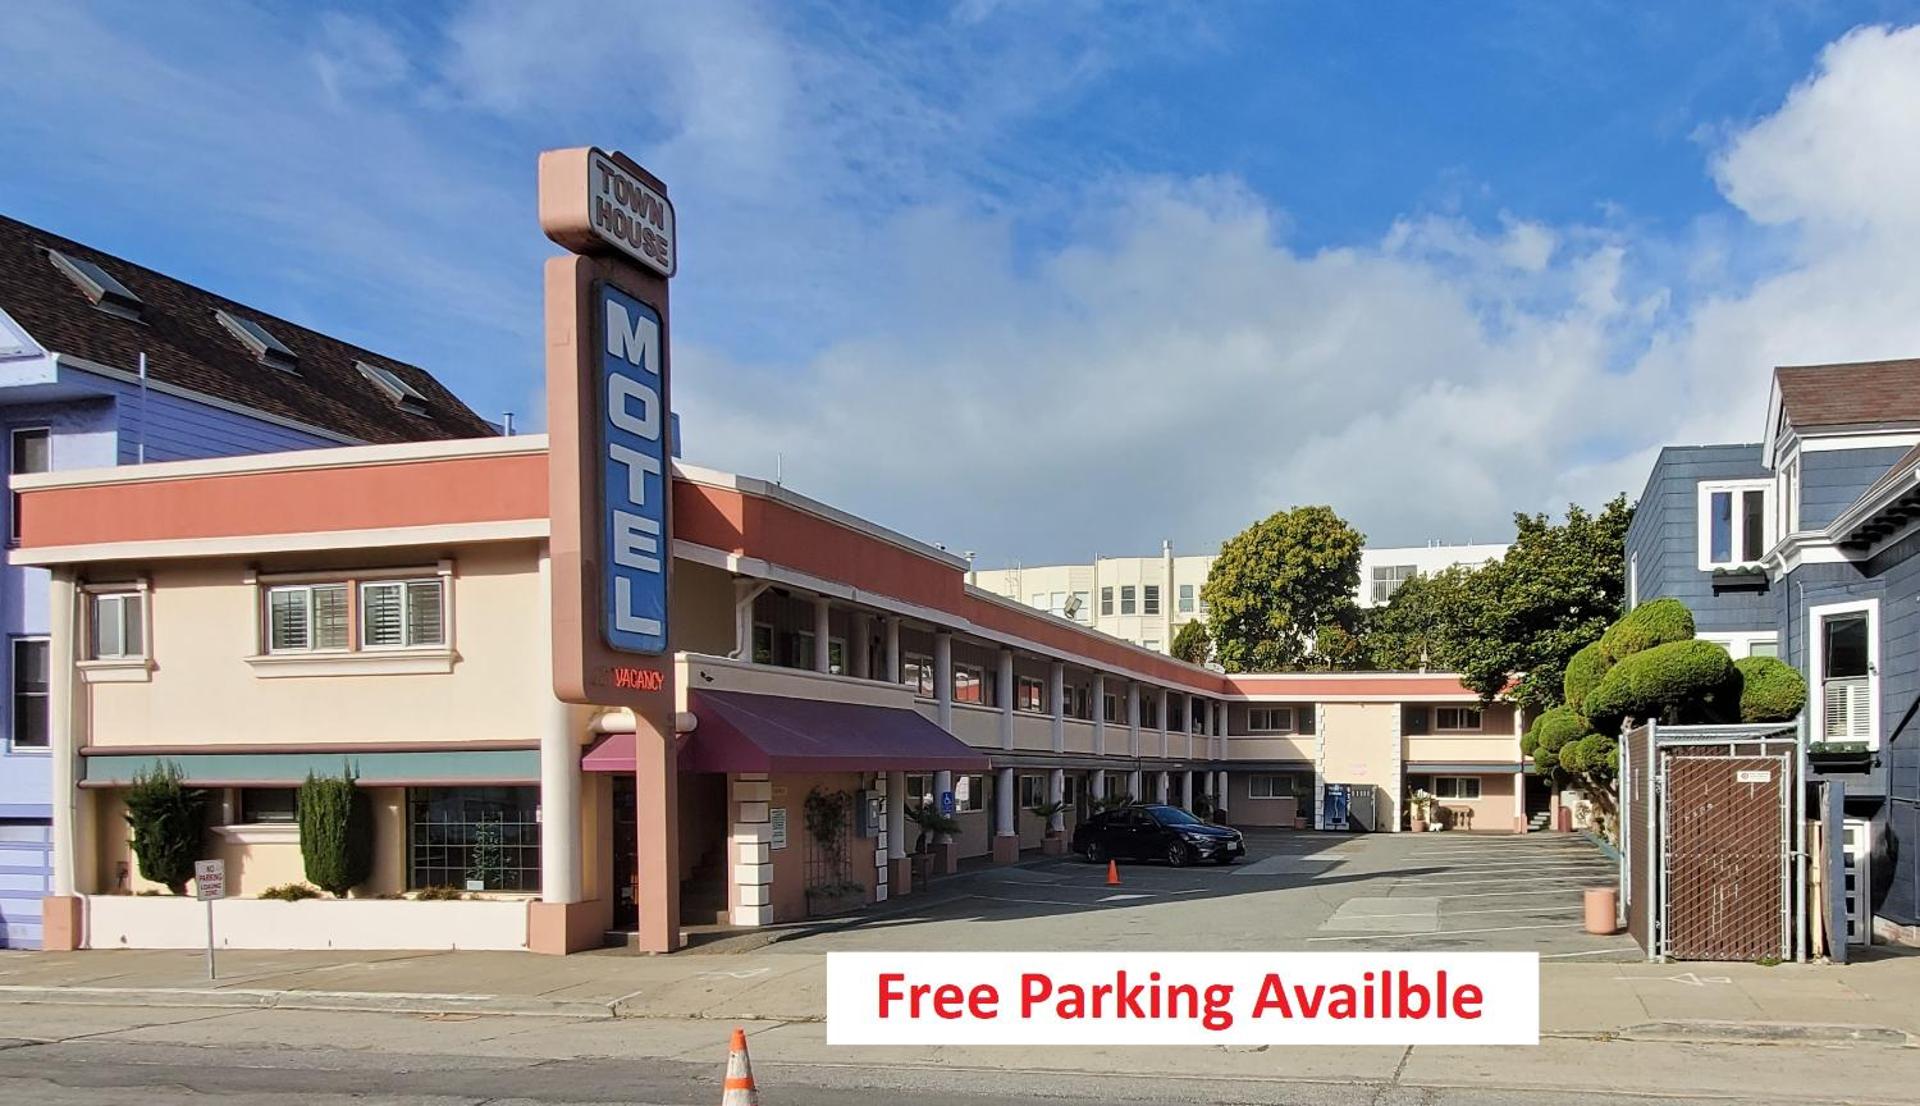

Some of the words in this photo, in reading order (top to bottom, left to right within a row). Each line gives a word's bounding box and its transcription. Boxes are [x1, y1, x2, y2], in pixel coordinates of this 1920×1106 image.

[596, 159, 664, 230] TOWN
[596, 196, 668, 267] HOUSE
[606, 298, 662, 637] MOTEL
[615, 667, 664, 691] VACANCY
